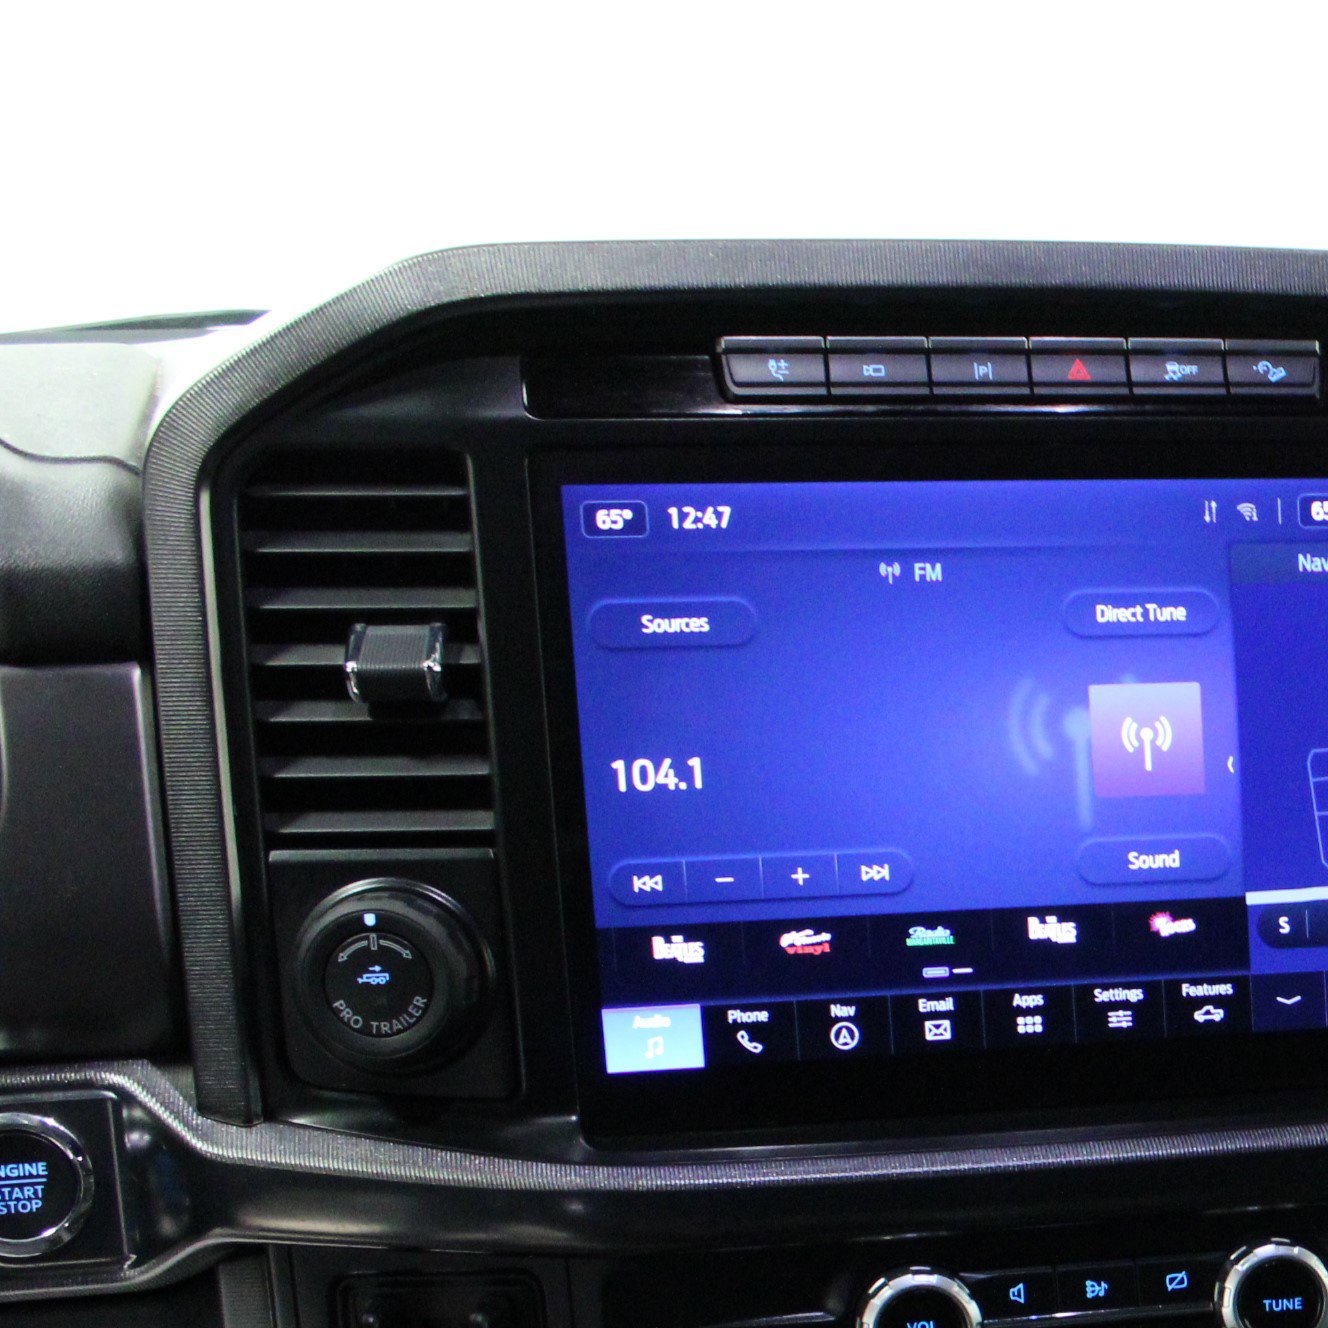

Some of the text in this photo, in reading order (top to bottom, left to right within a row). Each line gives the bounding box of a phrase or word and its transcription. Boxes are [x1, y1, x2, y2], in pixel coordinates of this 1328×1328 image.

[1180, 365, 1199, 376] OFF
[667, 505, 732, 530] 12:47
[913, 562, 943, 582] FM
[1095, 602, 1187, 623] Direct Tune
[640, 612, 710, 634] Sources
[610, 756, 703, 792] 104.1
[1127, 850, 1180, 870] Sound
[1279, 917, 1291, 934] S
[1093, 987, 1144, 1003] Settings
[1181, 982, 1234, 998] Features
[918, 996, 955, 1013] Email
[1012, 993, 1044, 1009] Apps
[332, 996, 428, 1035] PRO TRAILER
[727, 1009, 769, 1024] Phone
[830, 1004, 856, 1018] Nav
[0, 1185, 44, 1200] TART
[1262, 1297, 1303, 1312] TUNE
